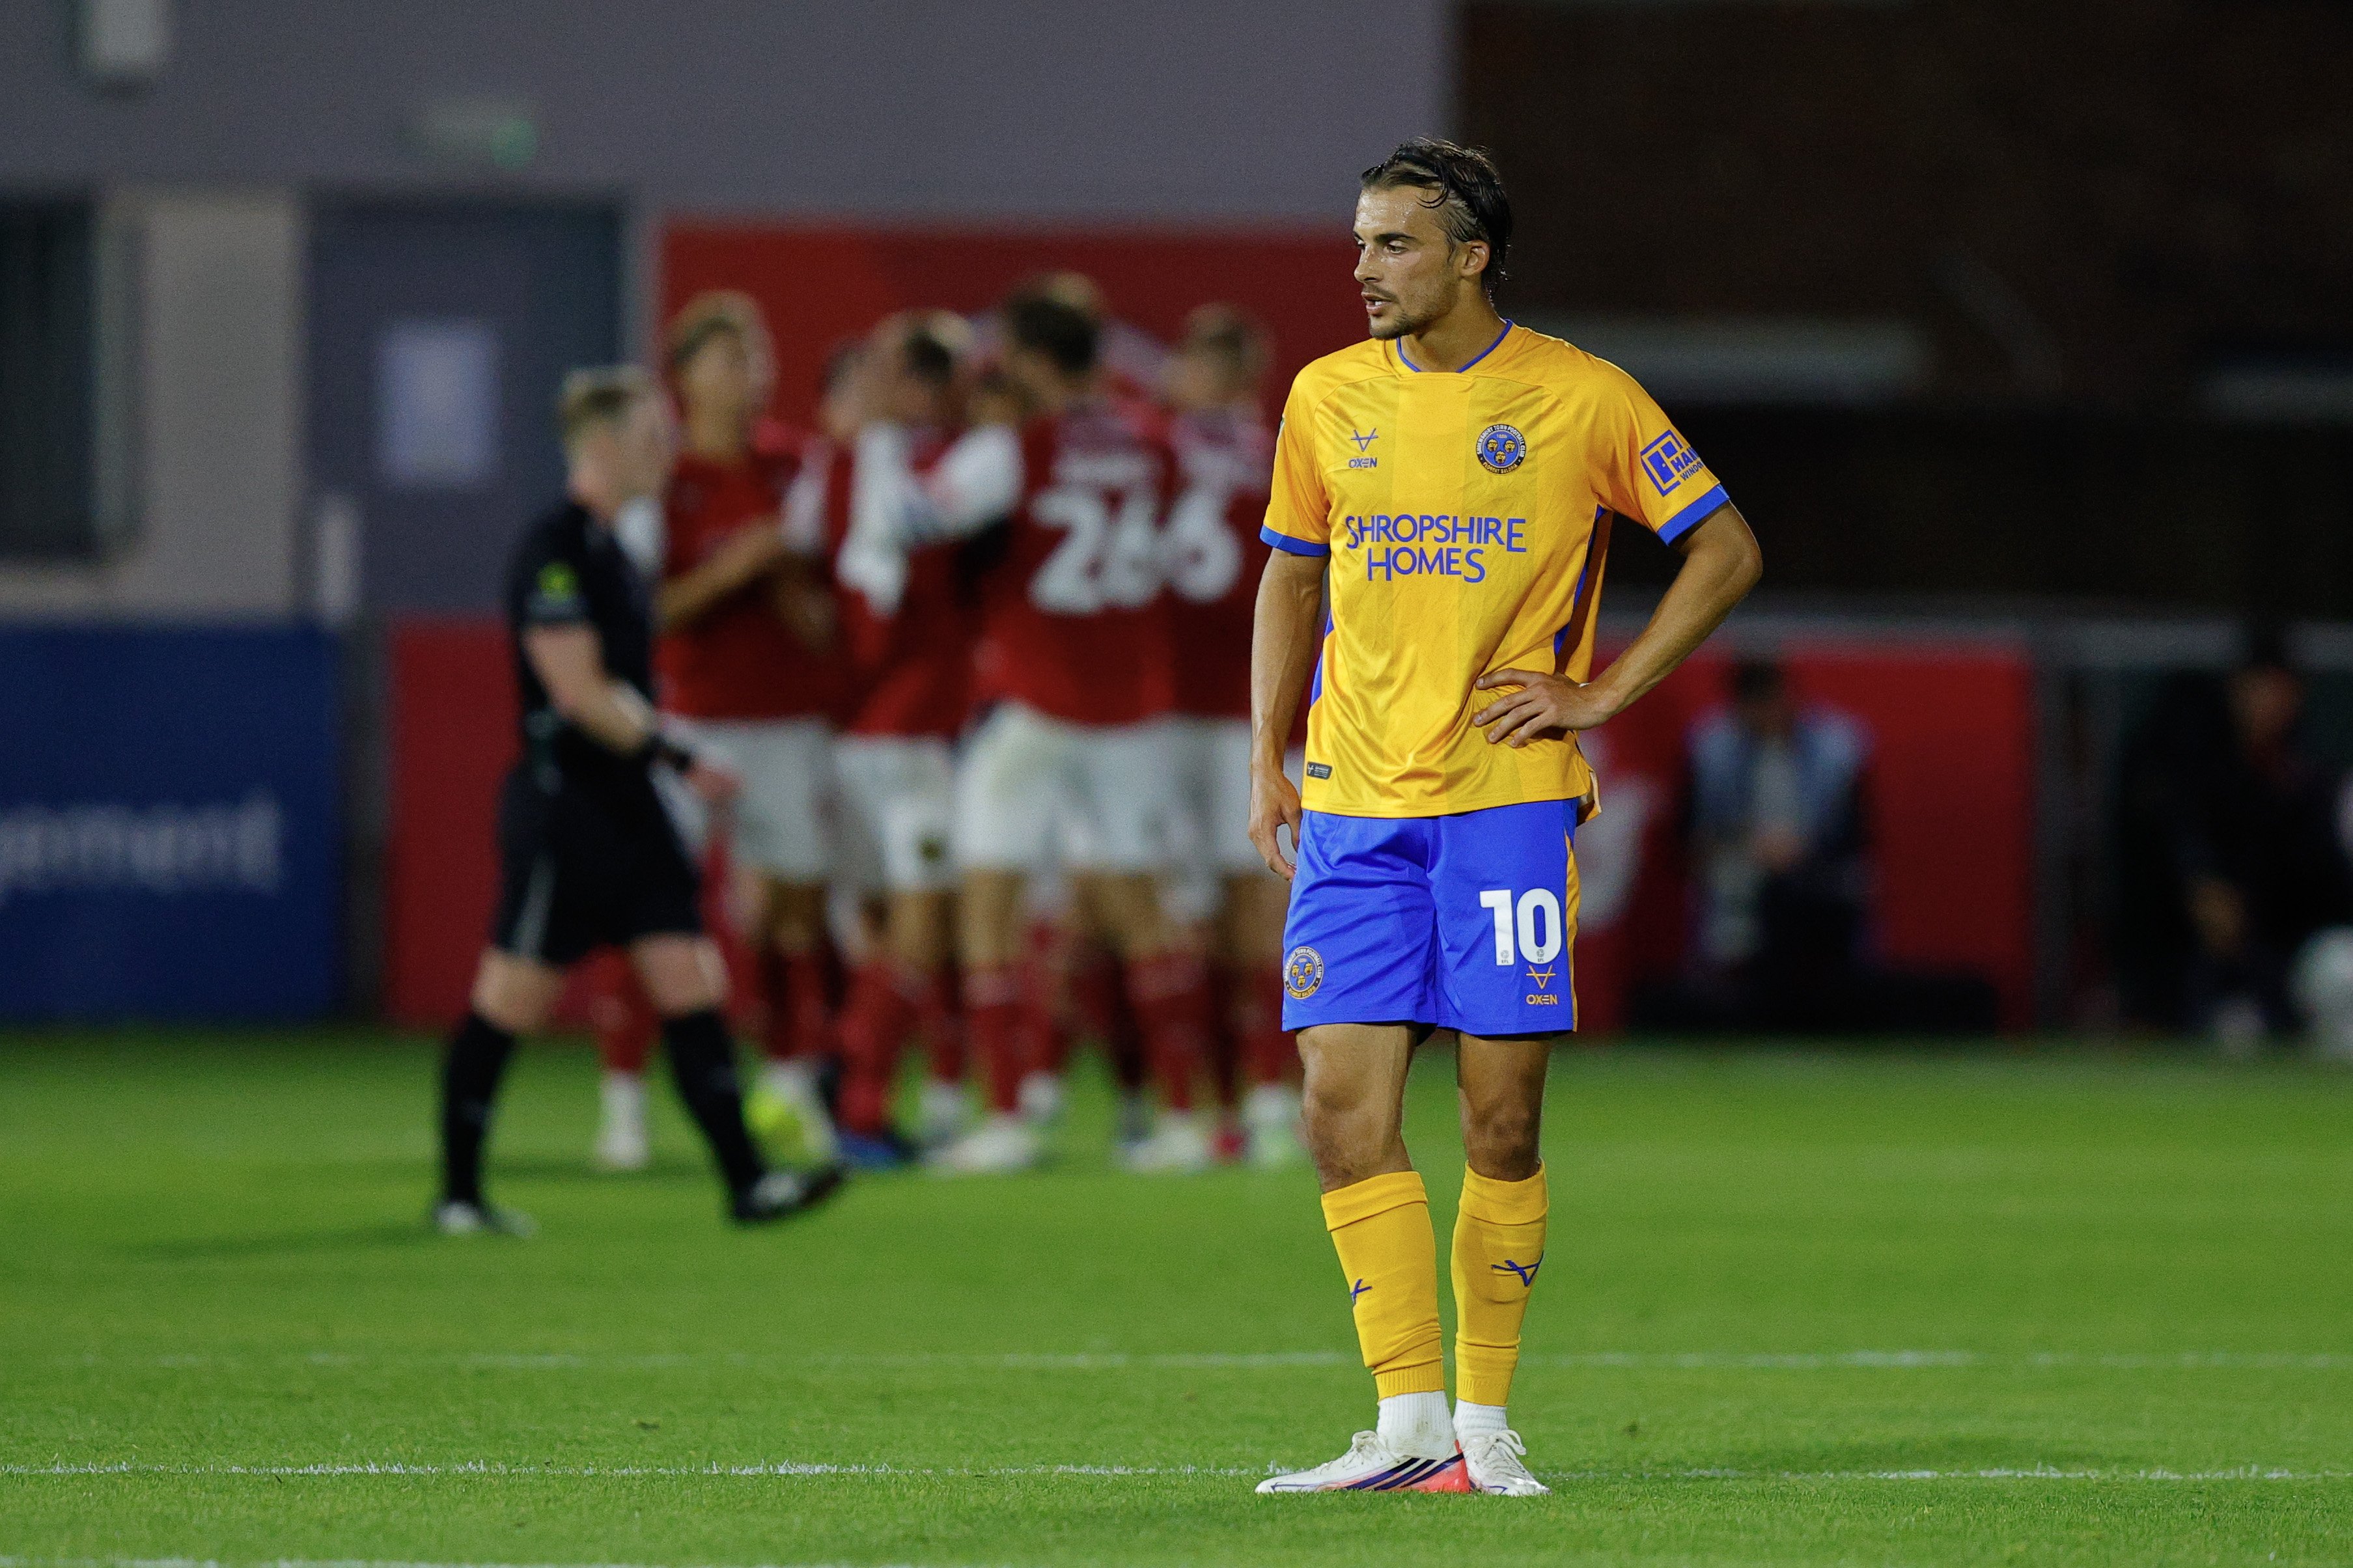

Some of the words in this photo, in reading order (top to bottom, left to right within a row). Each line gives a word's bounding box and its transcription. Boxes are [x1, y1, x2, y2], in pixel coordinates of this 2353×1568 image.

[1348, 457, 1377, 468] OXEN
[1029, 485, 1172, 615] 26
[1345, 514, 1527, 553] SHROPSHIRE
[1367, 546, 1485, 583] HOMES
[1479, 888, 1562, 966] 10
[1526, 994, 1559, 1005] OXEN
